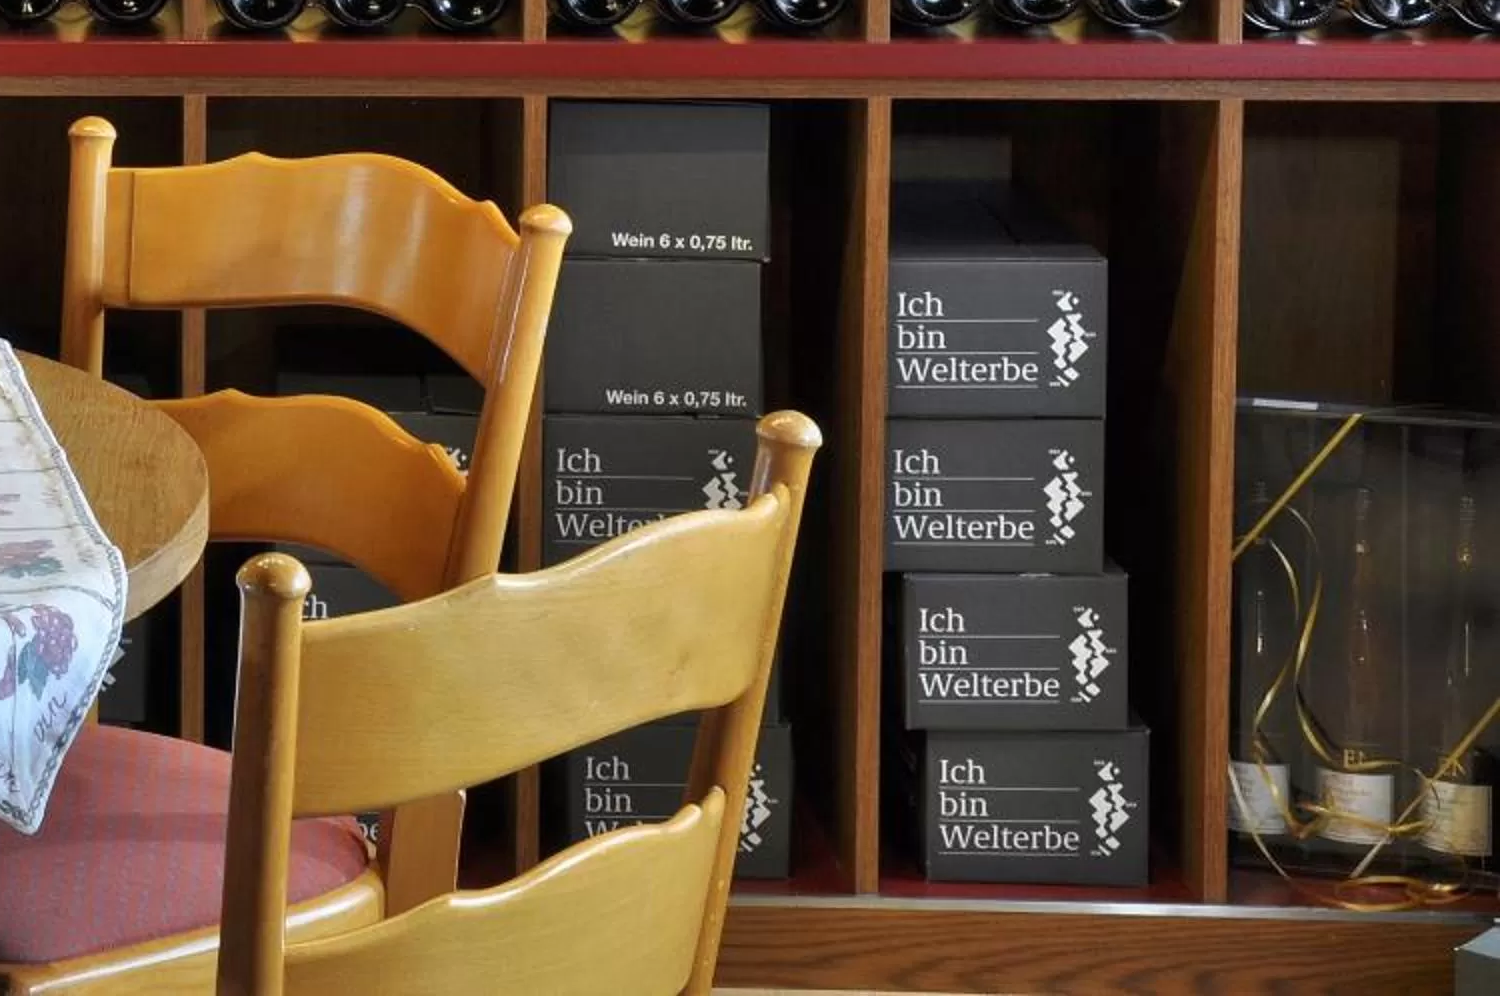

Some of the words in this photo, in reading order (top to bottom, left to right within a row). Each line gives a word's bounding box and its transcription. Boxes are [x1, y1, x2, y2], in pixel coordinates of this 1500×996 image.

[611, 232, 655, 248] Wein
[659, 232, 669, 248] 6
[675, 237, 685, 248] x
[689, 234, 727, 251] 0,75
[731, 235, 753, 251] ltr.
[897, 291, 944, 317] Ich
[897, 324, 947, 350] bin
[896, 357, 1039, 383] Welterbe
[606, 390, 649, 405] Wein
[653, 391, 665, 405] 6
[669, 395, 679, 405] x
[684, 391, 720, 408] 0,75
[725, 392, 747, 407] ltr.
[556, 447, 602, 473] Ich
[893, 449, 940, 475] Ich
[556, 480, 604, 505] bin
[893, 481, 944, 507] bin
[555, 513, 667, 537] Welte
[893, 514, 1035, 540] Welterbe
[919, 607, 965, 633] Ich
[918, 639, 969, 665] bin
[918, 672, 1060, 698] Welterbe
[585, 755, 631, 781] Ich
[939, 759, 986, 785] Ich
[584, 787, 633, 813] bin
[939, 791, 989, 817] bin
[939, 824, 1080, 851] Welterbe
